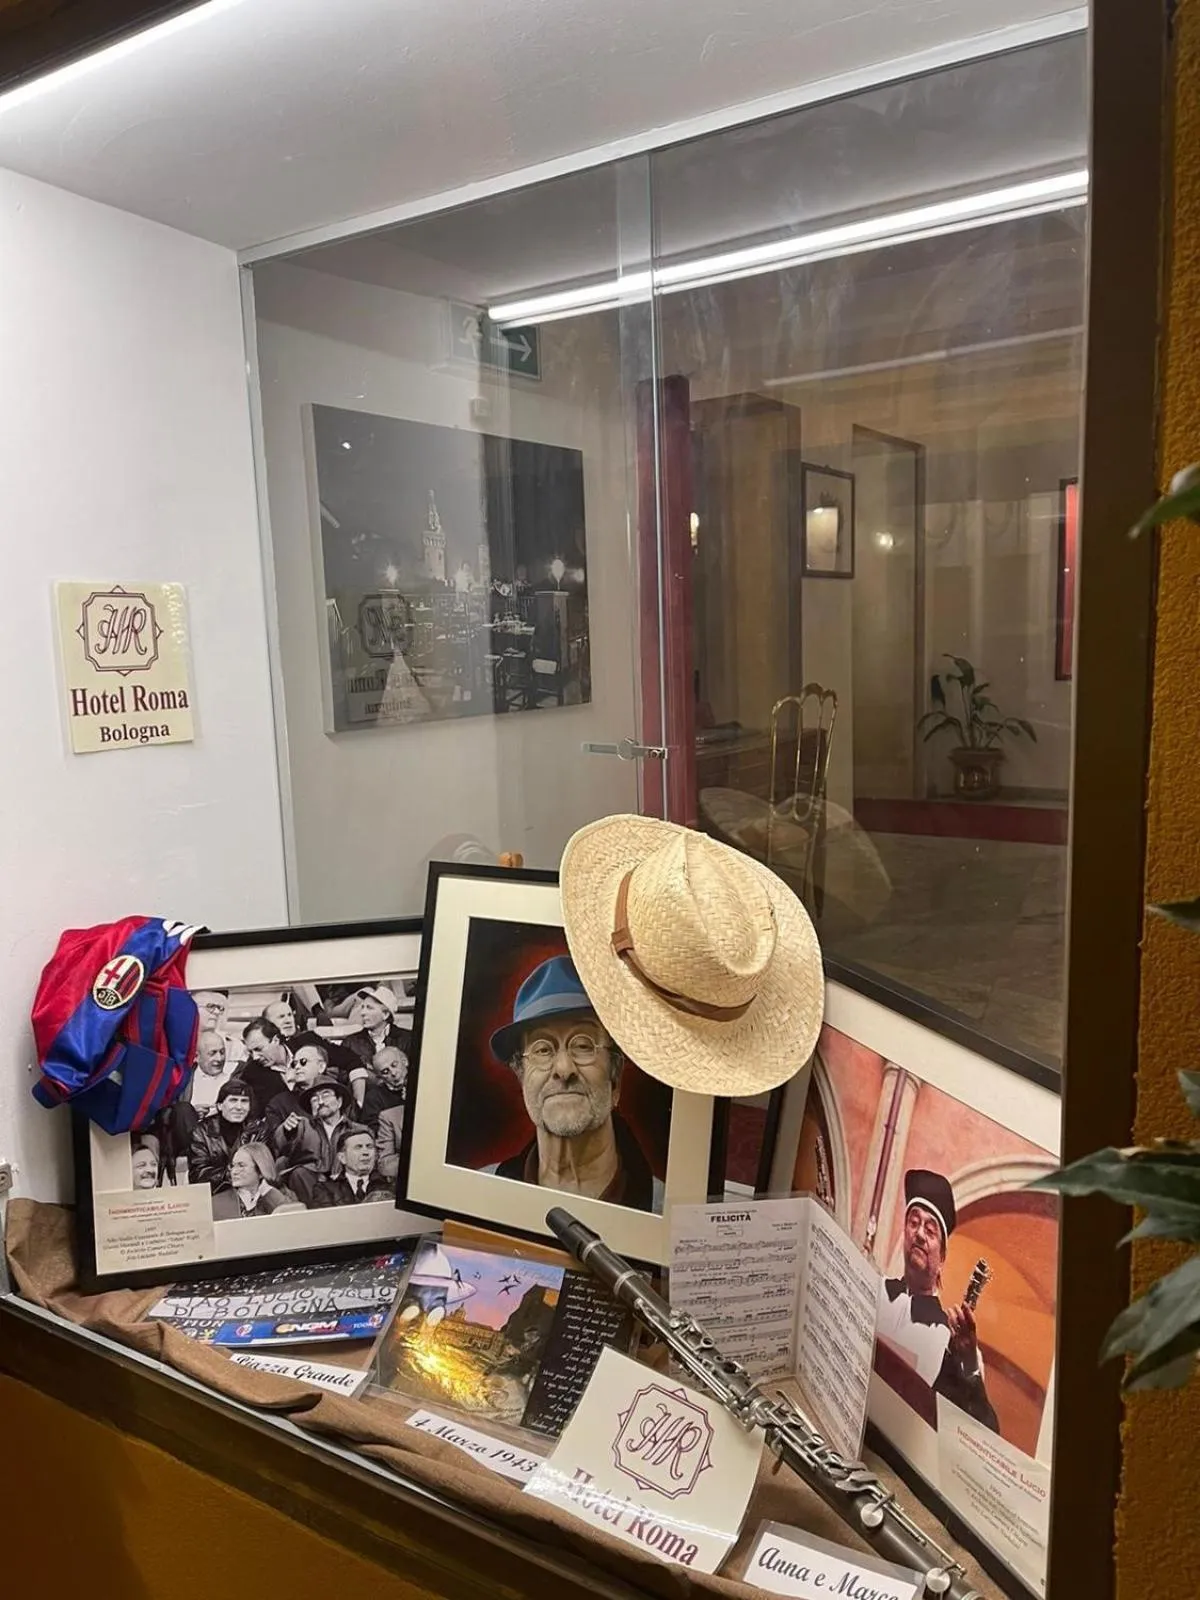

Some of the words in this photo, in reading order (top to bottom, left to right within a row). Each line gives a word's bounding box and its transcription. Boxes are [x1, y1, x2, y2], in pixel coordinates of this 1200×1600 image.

[70, 686, 126, 717] Hotel
[131, 684, 189, 713] Roma
[99, 723, 170, 743] Bologna
[710, 1213, 752, 1223] FELICITÀ
[163, 1296, 230, 1308] CIAO
[174, 1306, 196, 1317] DI
[212, 1299, 339, 1320] BOLOGNA
[237, 1355, 290, 1375] Piazza
[293, 1364, 355, 1388] Grande
[414, 1418, 431, 1428] 4
[426, 1425, 488, 1455] Marzo
[488, 1448, 539, 1473] 1943
[1019, 1473, 1047, 1498] LUCIO
[624, 1506, 699, 1566] Roma
[757, 1546, 811, 1582] Anna
[813, 1572, 827, 1587] e
